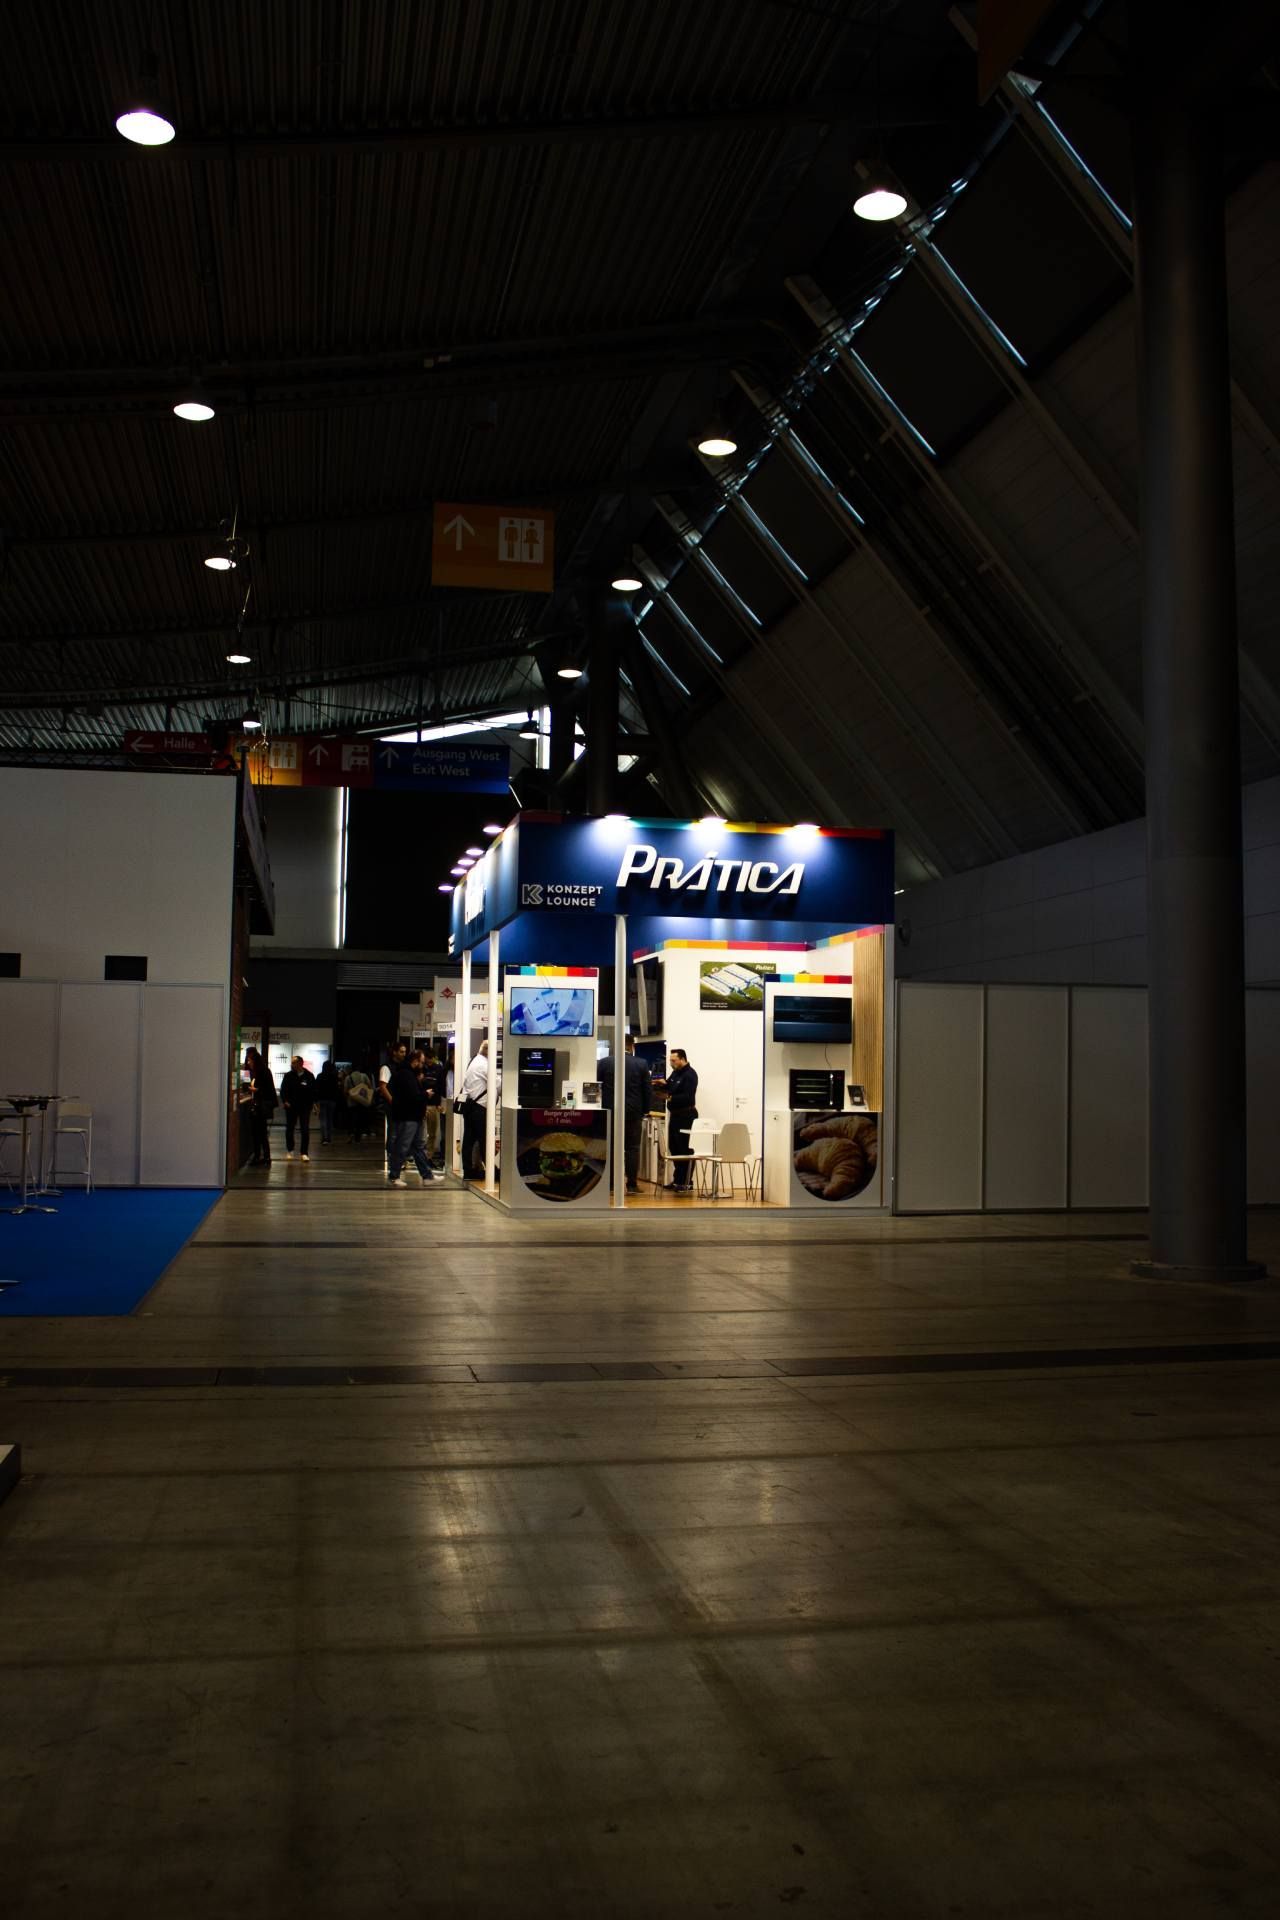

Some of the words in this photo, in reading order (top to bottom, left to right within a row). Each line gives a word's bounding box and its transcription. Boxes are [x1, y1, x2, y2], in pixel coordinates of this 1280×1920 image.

[163, 736, 196, 749] Halle
[412, 746, 466, 762] Ausgang
[468, 749, 501, 761] West
[412, 763, 437, 775] Exit
[439, 764, 471, 777] West
[547, 884, 603, 895] KONZEPT
[547, 896, 596, 907] LOUNGE
